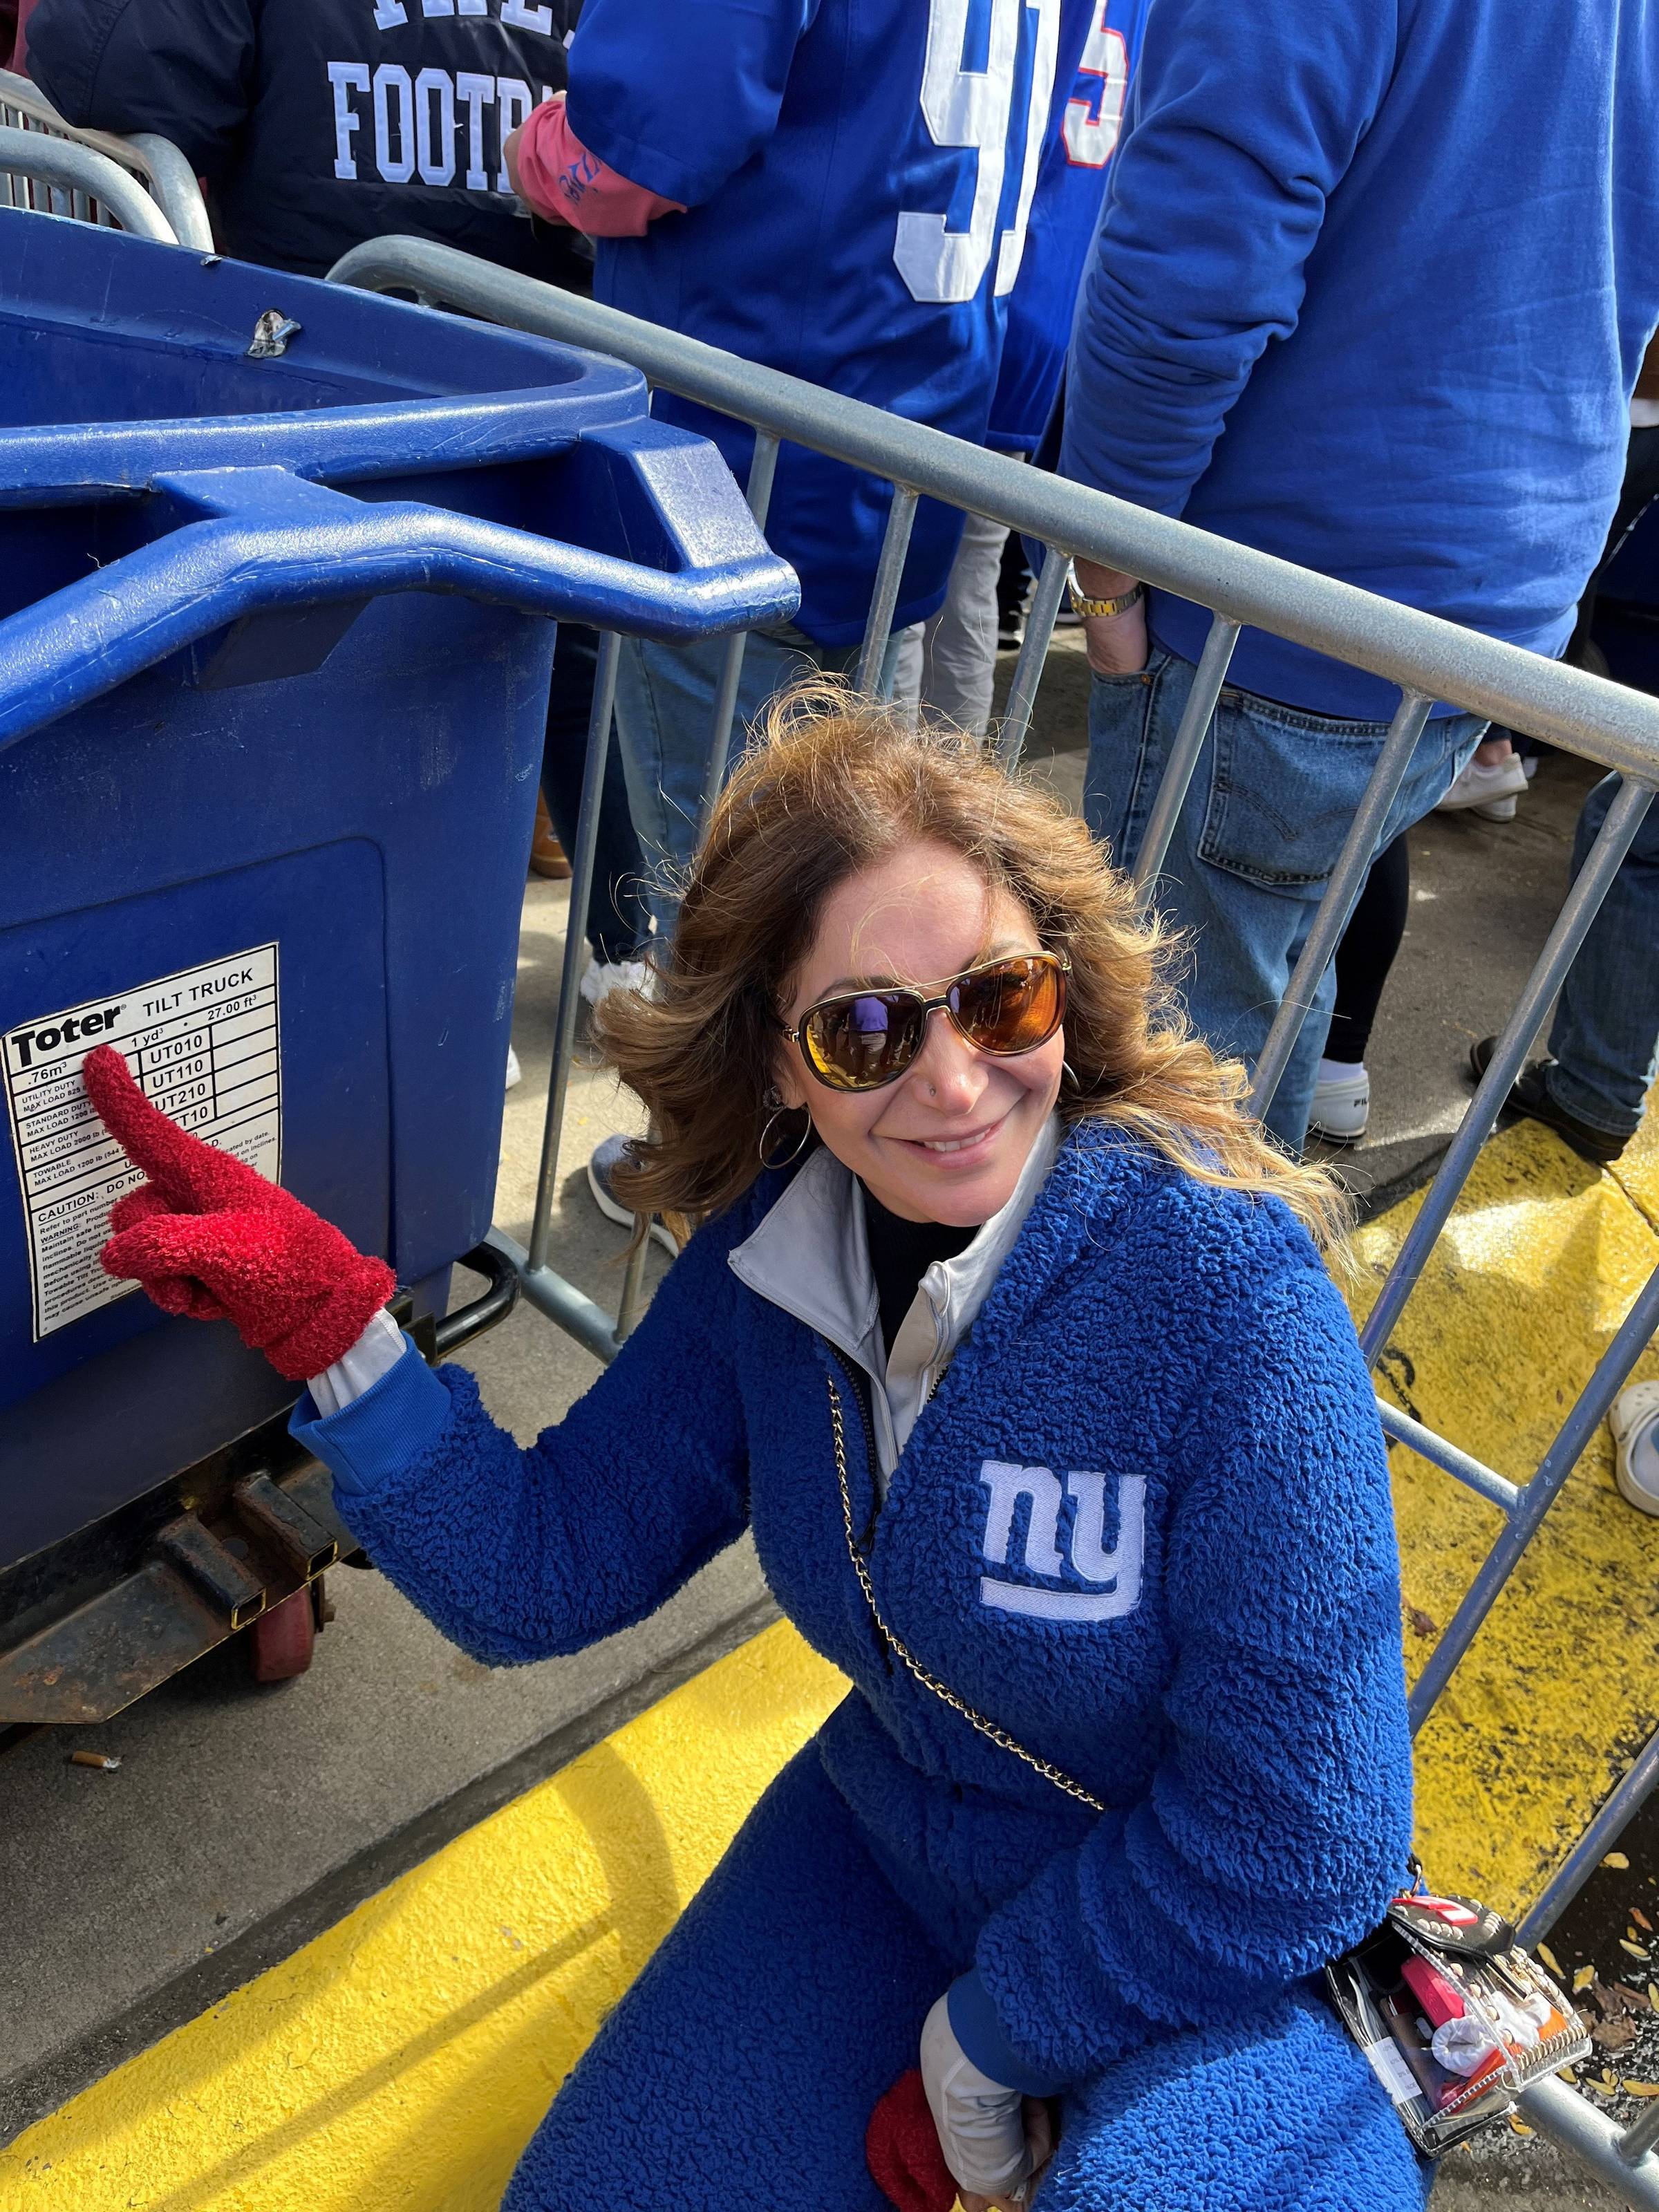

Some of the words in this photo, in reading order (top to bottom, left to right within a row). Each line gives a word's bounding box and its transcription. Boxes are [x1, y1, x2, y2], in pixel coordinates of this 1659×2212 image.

[327, 61, 554, 194] FOOTB
[142, 992, 182, 1016] TILT
[188, 968, 254, 1001] TRUCK
[131, 1038, 137, 1047] 1
[207, 1001, 240, 1020] 27.00
[151, 1035, 202, 1064] UT010
[153, 1060, 203, 1088] UT110
[22, 1088, 51, 1104] UTILITY
[55, 1080, 75, 1092] DUTY
[24, 1102, 41, 1112] MAX
[44, 1092, 65, 1105] LOAD
[155, 1083, 205, 1112] UT210
[1353, 1098, 1368, 1107] FIL
[26, 1108, 68, 1129] STANDARD
[27, 1127, 44, 1138] MAX
[47, 1118, 68, 1130] LOAD
[174, 1106, 207, 1126] T10
[30, 1139, 55, 1154] HEAVY
[57, 1131, 78, 1143] DUTY
[30, 1152, 48, 1162] MAX
[50, 1143, 72, 1154] LOAD
[74, 1135, 91, 1145] 2000
[251, 1137, 276, 1151] inclines.
[33, 1159, 71, 1178] TOWABLE
[35, 1177, 52, 1187] MAX
[54, 1166, 75, 1179] LOAD
[38, 1192, 98, 1222] CAUTION:
[106, 1180, 124, 1194] DO
[128, 1172, 145, 1184] NO
[40, 1222, 60, 1235] Refer
[73, 1211, 88, 1222] part
[90, 1198, 118, 1213] number
[41, 1236, 74, 1253] Maintain
[76, 1228, 91, 1238] safe
[76, 1239, 86, 1247] Do
[88, 1232, 101, 1241] not
